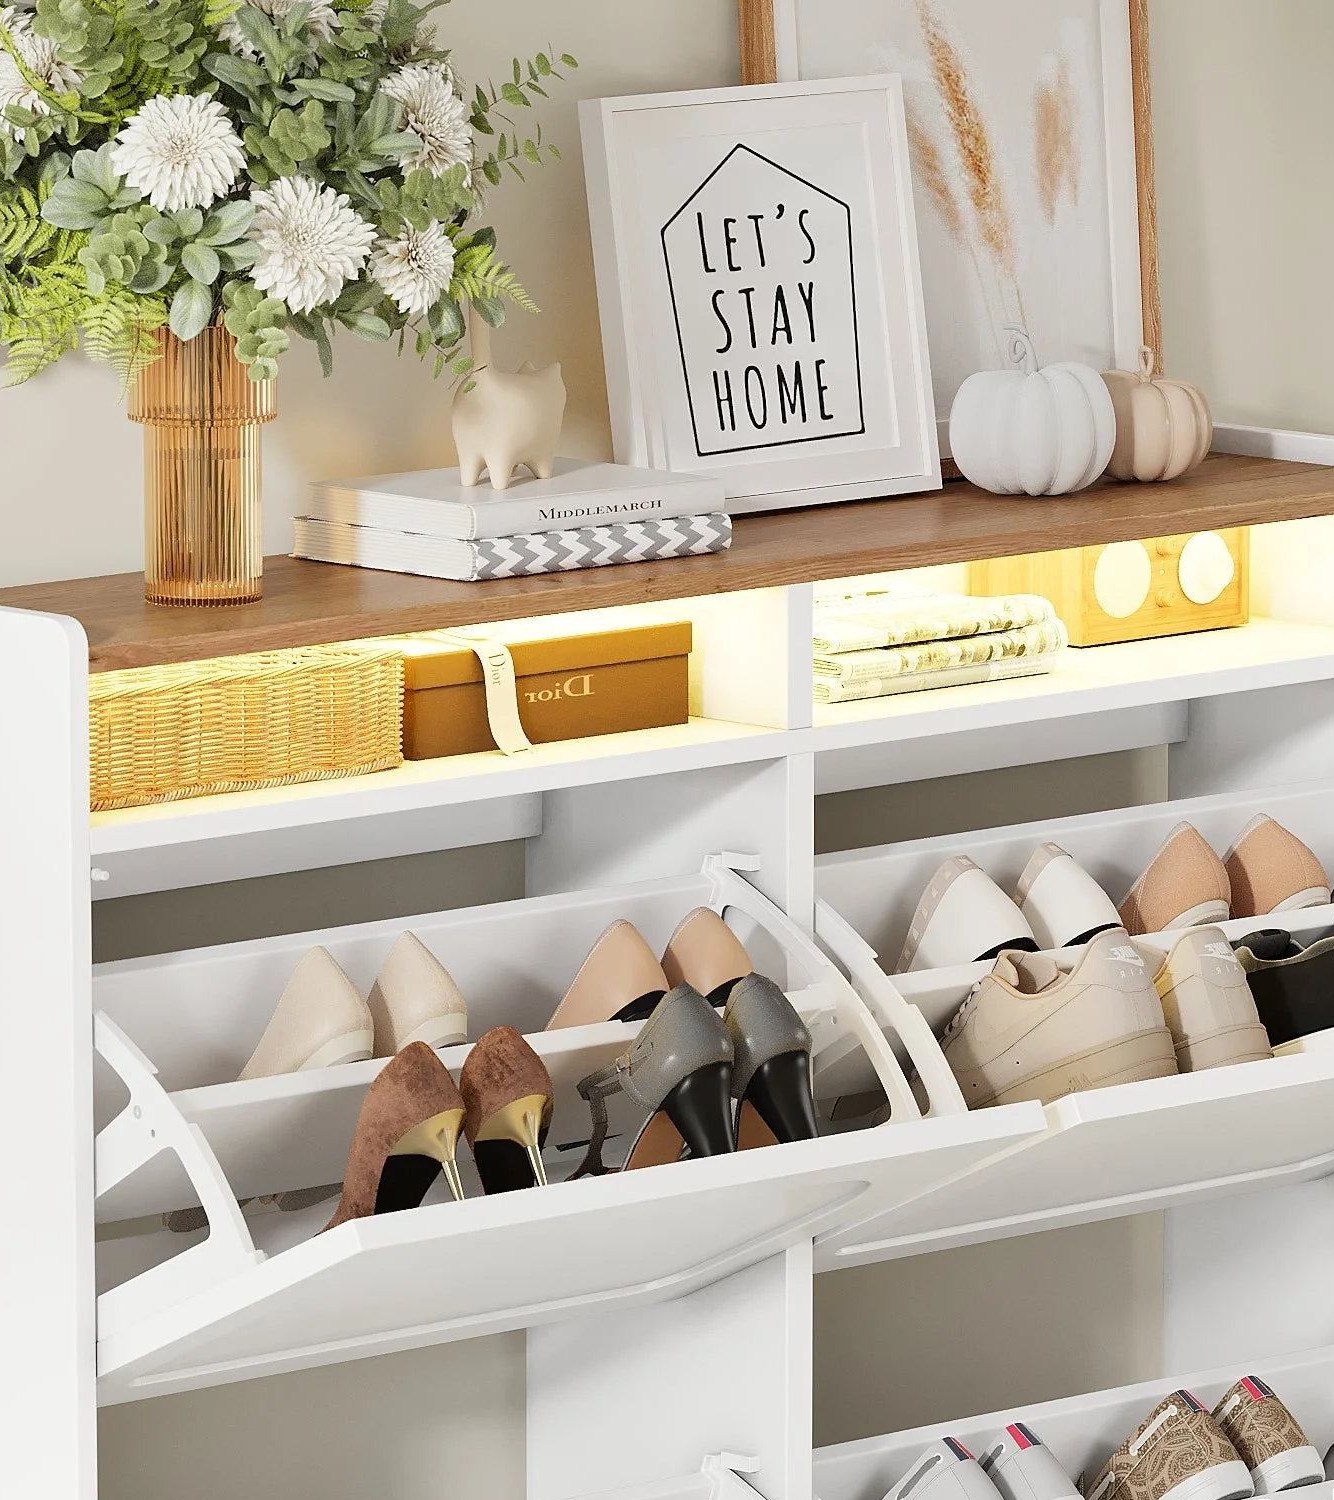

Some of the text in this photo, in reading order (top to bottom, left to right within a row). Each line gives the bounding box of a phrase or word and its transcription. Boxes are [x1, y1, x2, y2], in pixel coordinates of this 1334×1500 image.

[696, 203, 816, 273] LET'S
[711, 281, 816, 354] STAY
[712, 359, 833, 431] HOME
[537, 499, 663, 522] MIDDLEMARCH
[487, 652, 507, 687] Dior
